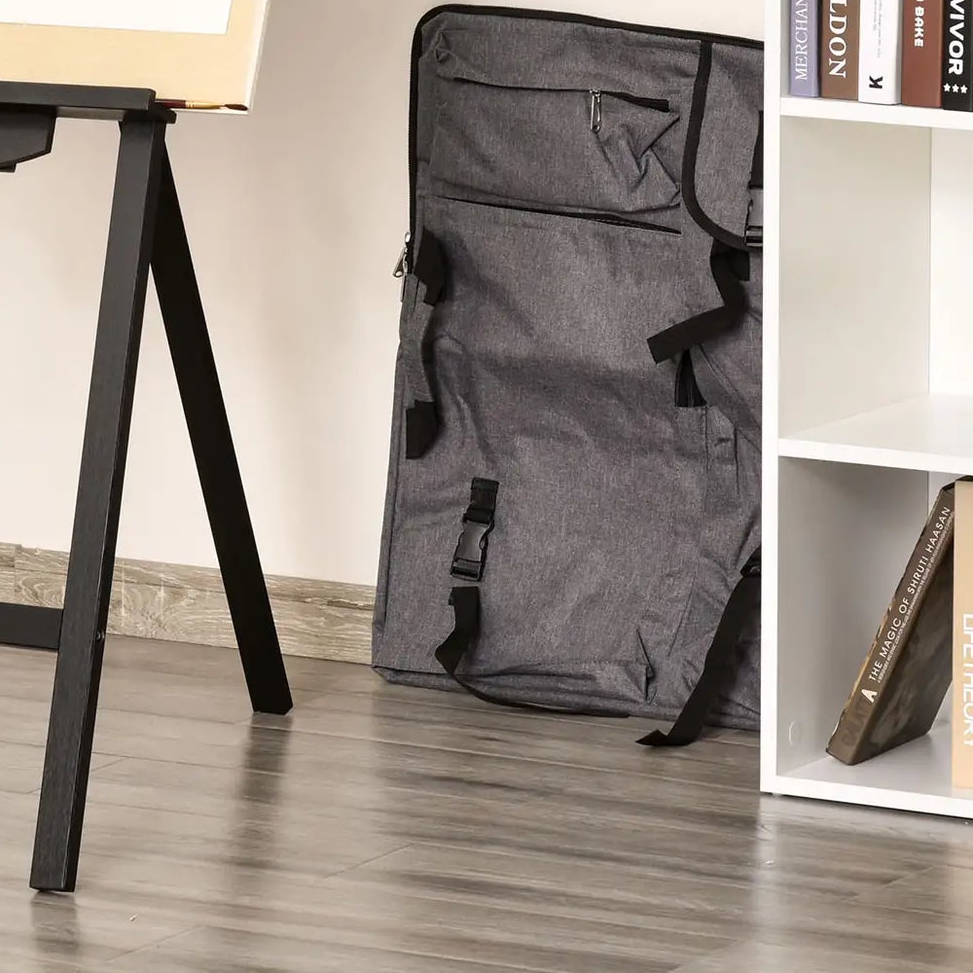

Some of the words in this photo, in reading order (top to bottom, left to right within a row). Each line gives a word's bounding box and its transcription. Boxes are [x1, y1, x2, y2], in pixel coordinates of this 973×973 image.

[914, 5, 925, 47] BAKE
[868, 75, 884, 89] K
[868, 660, 882, 682] THE
[879, 617, 902, 660] MAGIC
[898, 597, 911, 615] OF
[907, 556, 929, 595] SHRUTI
[925, 506, 951, 554] HAASAN
